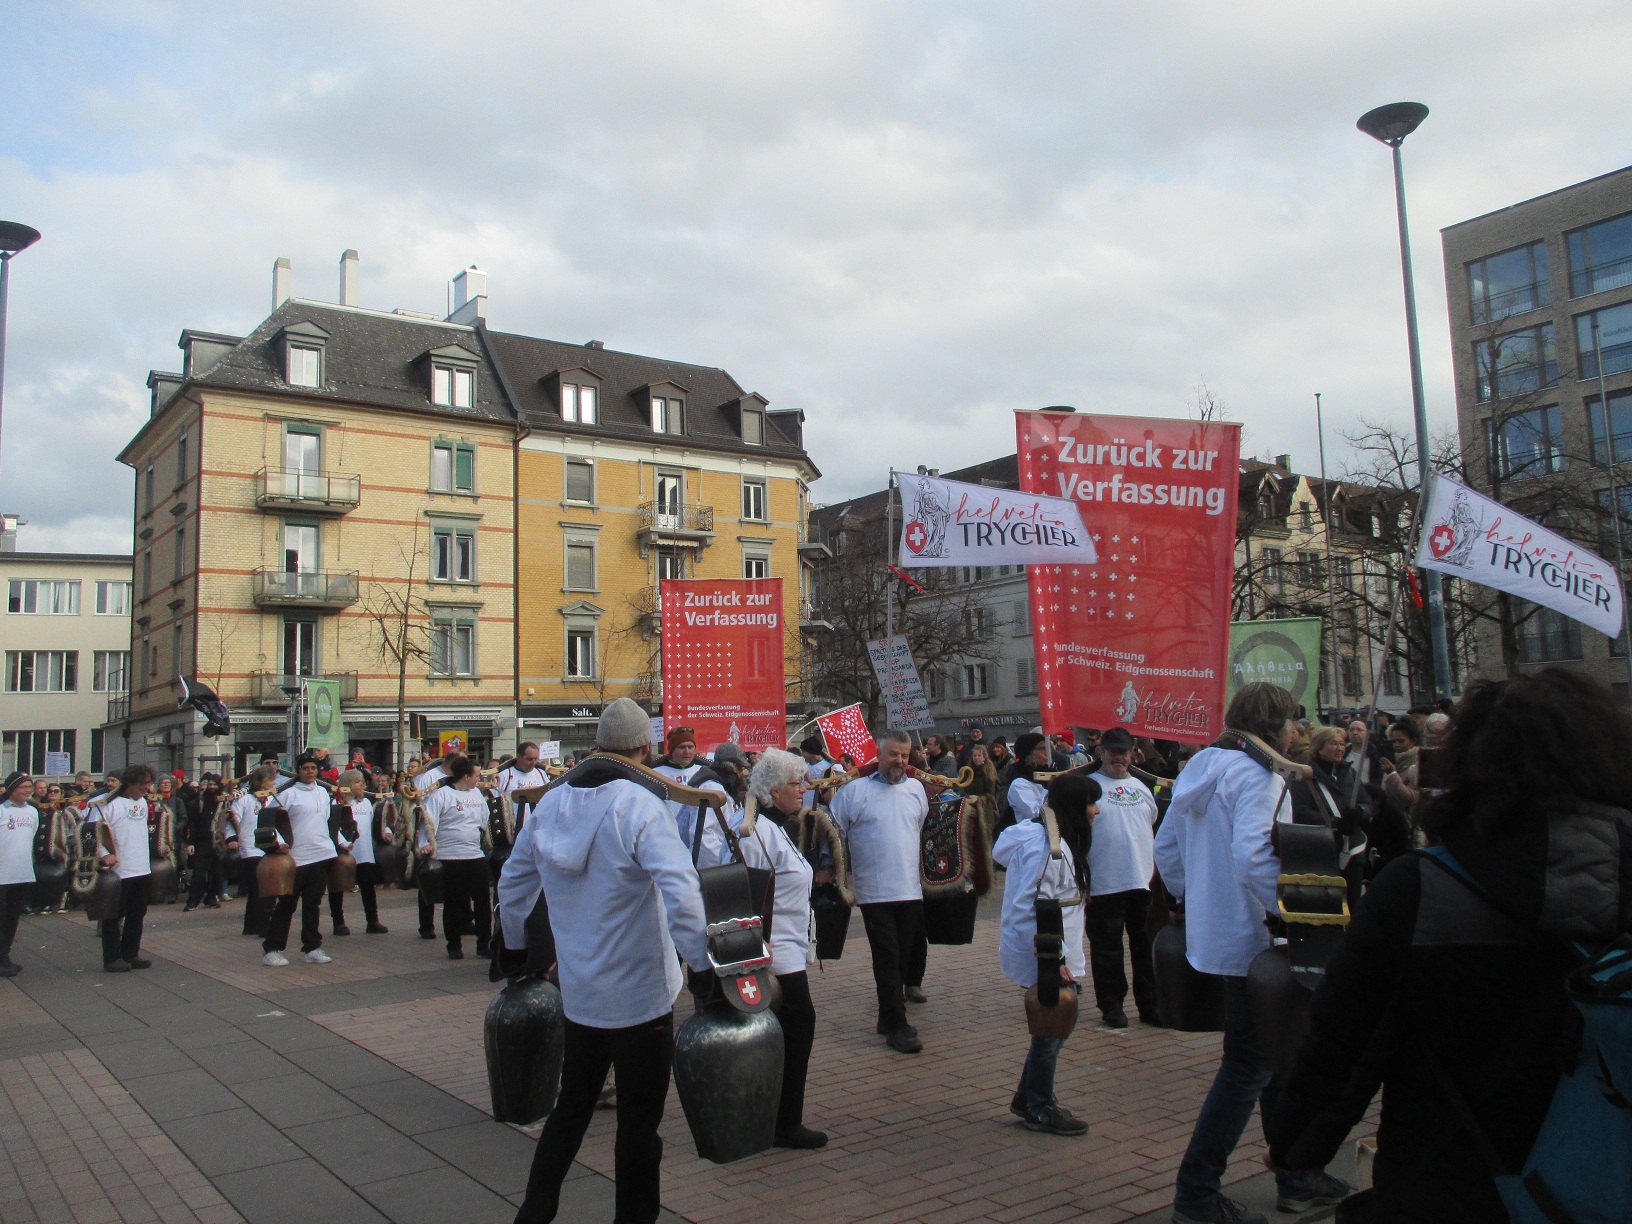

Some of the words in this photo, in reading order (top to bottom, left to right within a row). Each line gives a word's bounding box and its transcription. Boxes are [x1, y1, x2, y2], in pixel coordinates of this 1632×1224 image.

[1058, 436, 1163, 468] Zurück
[1171, 448, 1219, 471] zur
[1057, 472, 1226, 516] Verfassung
[950, 492, 1077, 530] helvetia
[956, 522, 1081, 547] TRYCHLER
[1486, 540, 1612, 613] TRYCHLER
[684, 590, 742, 607] Zurück
[746, 593, 773, 606] zur
[684, 610, 778, 628] Verfassung
[1067, 655, 1113, 670] Schweiz.
[1115, 662, 1214, 679] Eidgenossenschaft
[892, 685, 908, 694] STOP
[572, 707, 593, 717] Salt.
[687, 704, 741, 712] Bundesverfassung
[899, 701, 915, 710] STOP
[725, 710, 780, 719] Eidgenossenschaft
[902, 711, 920, 721] STOP
